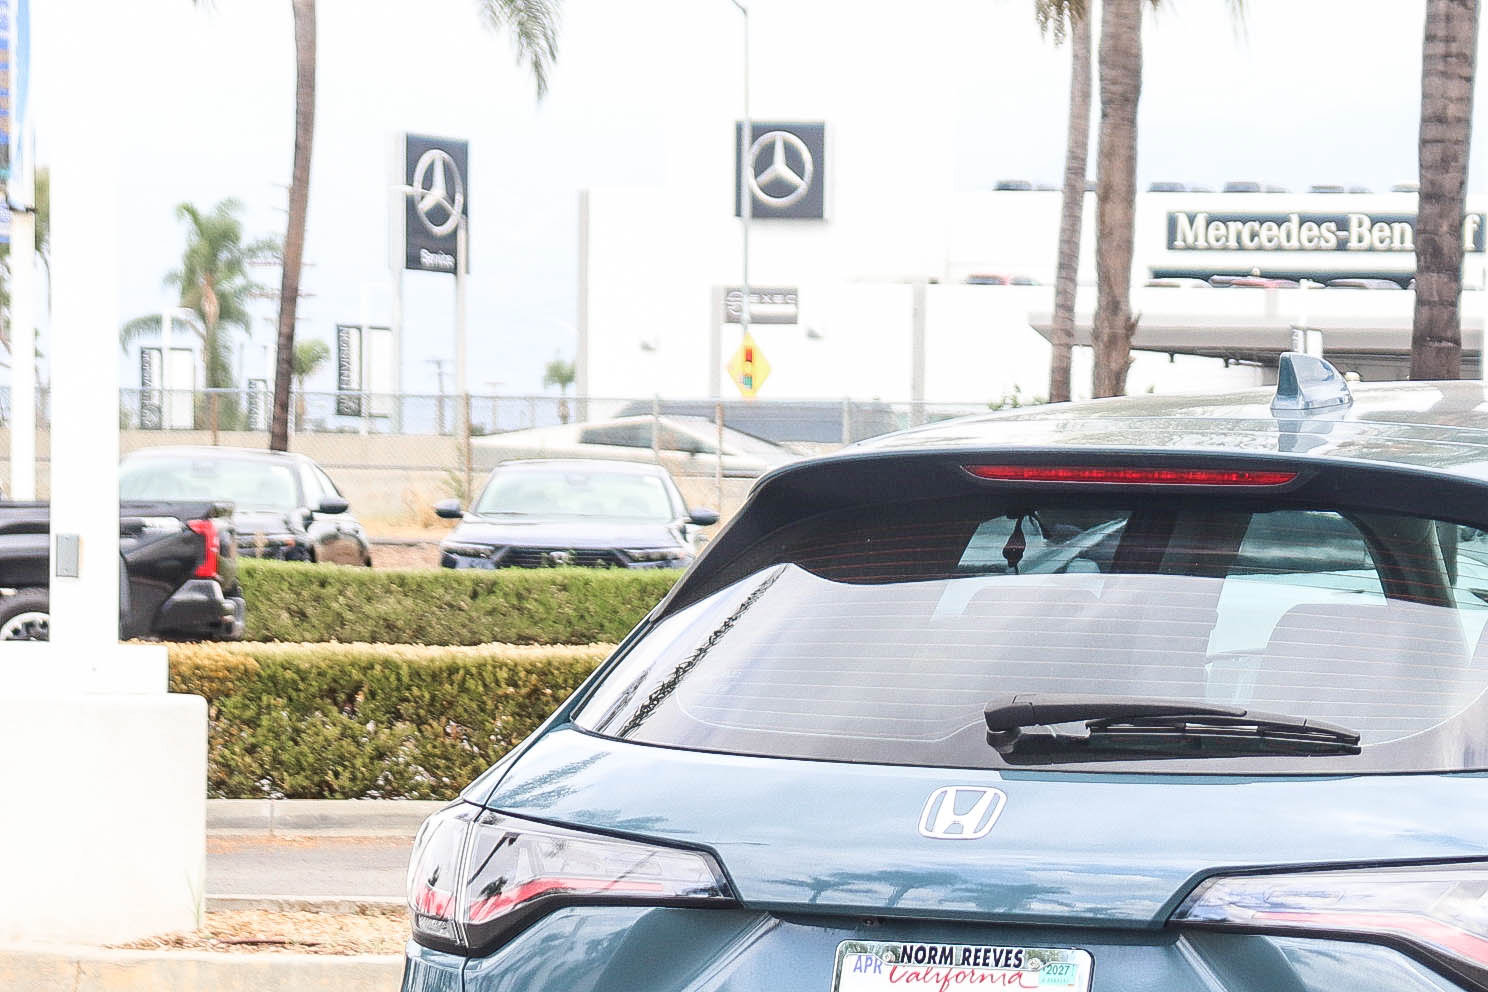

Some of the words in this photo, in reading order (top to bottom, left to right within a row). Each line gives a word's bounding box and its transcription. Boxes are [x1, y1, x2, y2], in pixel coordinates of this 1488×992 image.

[1173, 212, 1415, 250] Mercedes-Ben
[853, 954, 883, 975] APR
[901, 944, 954, 966] NORM
[962, 947, 1024, 969] REEVES
[1045, 964, 1071, 976] 2027
